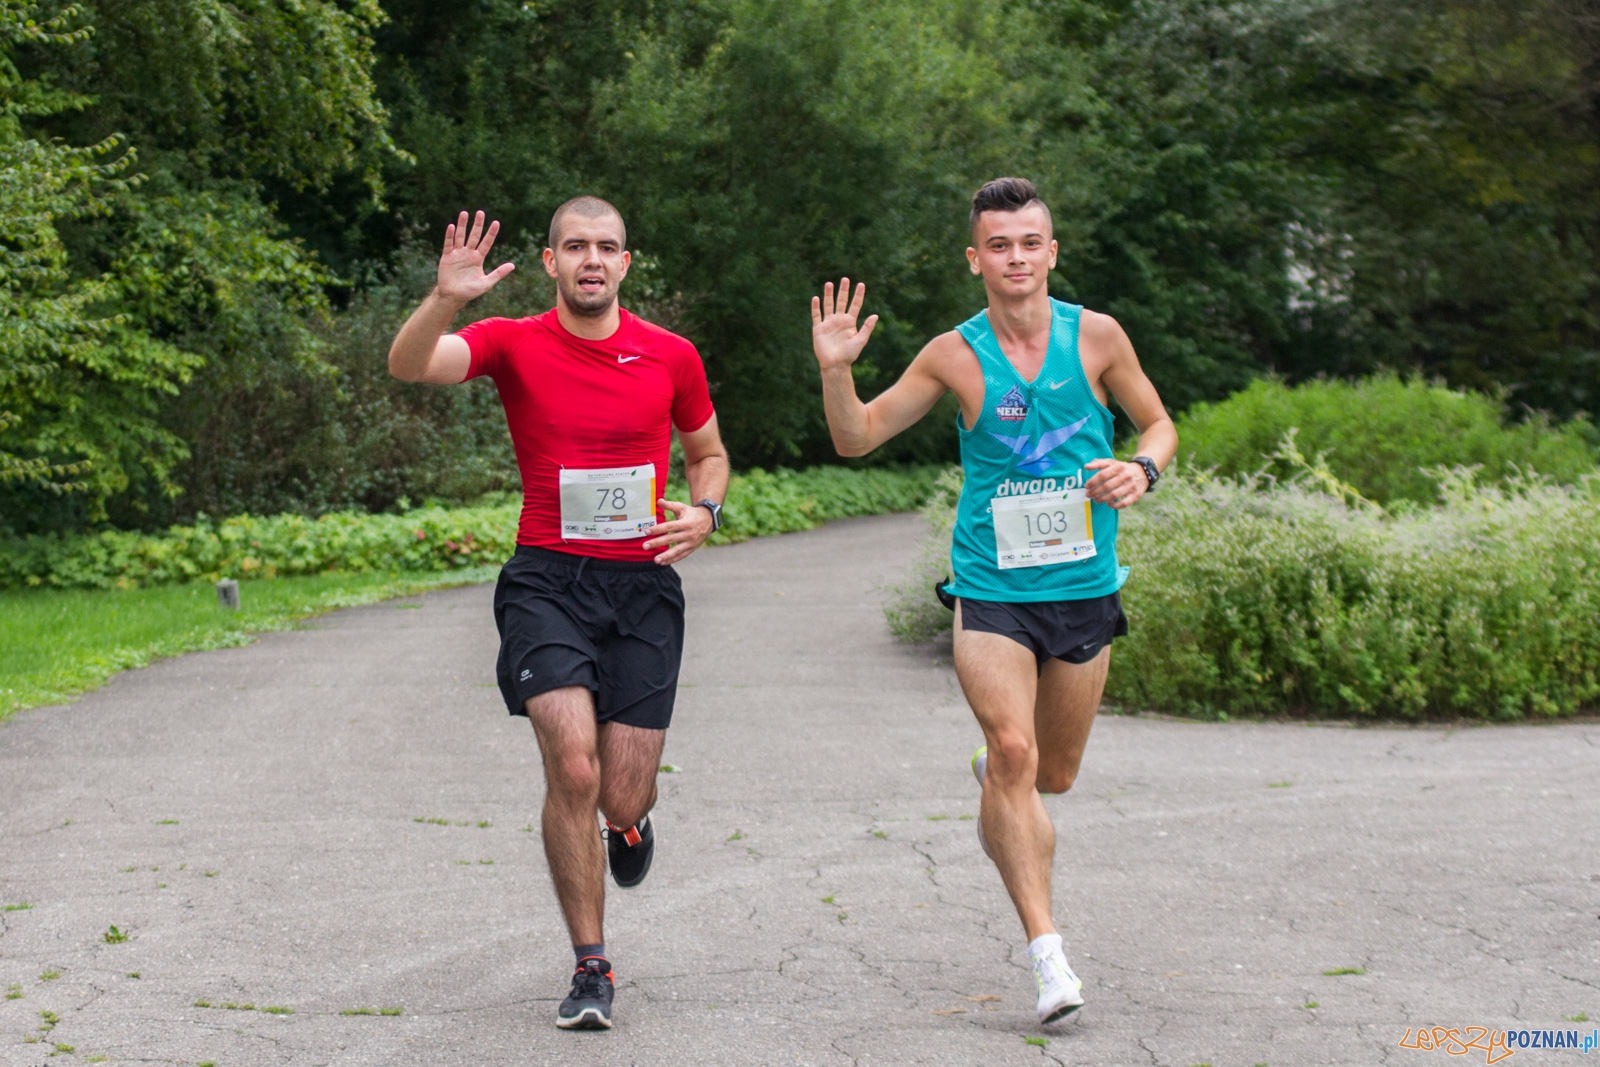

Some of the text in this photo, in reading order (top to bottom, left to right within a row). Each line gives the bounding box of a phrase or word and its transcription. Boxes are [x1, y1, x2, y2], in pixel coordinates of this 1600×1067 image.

[997, 469, 1083, 497] dwap.pl
[597, 488, 627, 510] 78
[1024, 510, 1067, 536] 103
